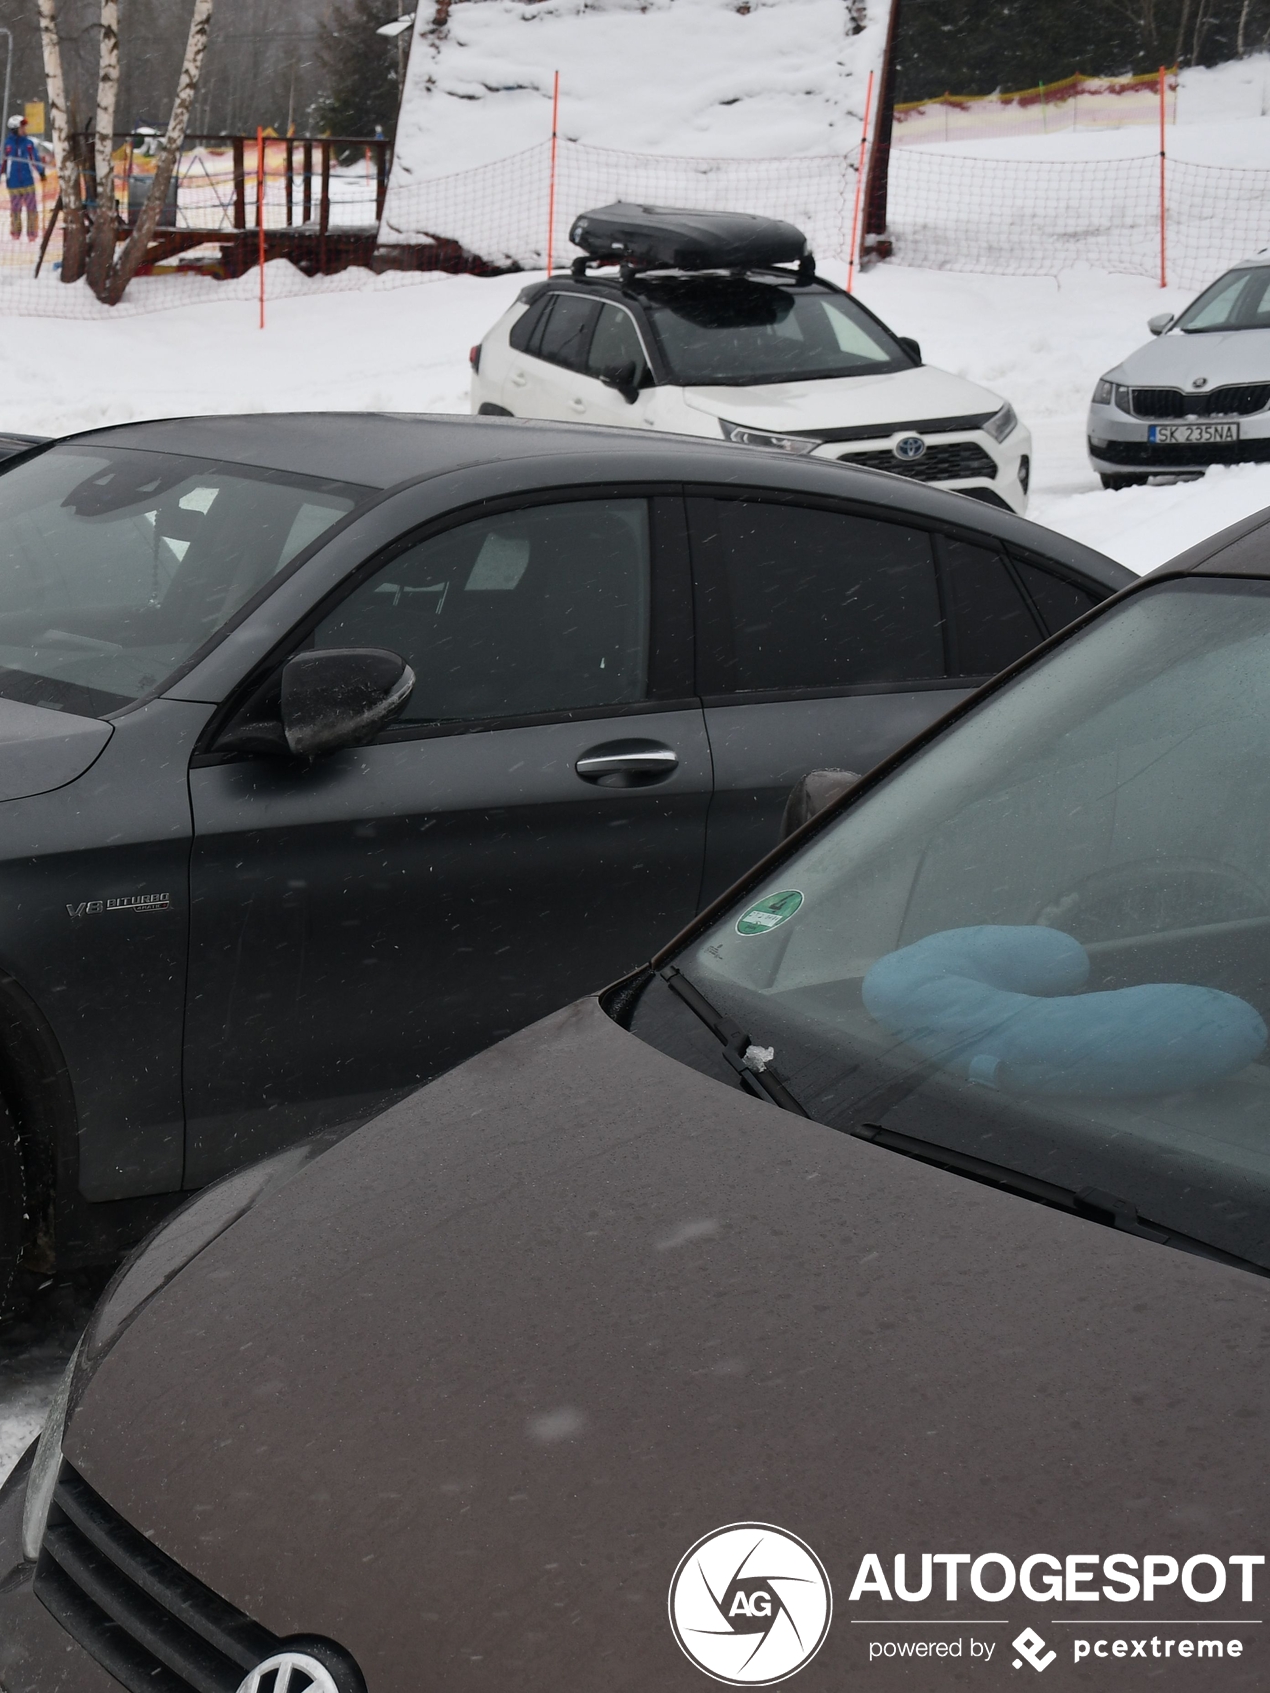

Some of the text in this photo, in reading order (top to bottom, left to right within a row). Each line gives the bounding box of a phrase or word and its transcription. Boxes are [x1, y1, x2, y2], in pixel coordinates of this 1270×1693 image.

[1158, 426, 1234, 442] SK 235NA
[66, 892, 170, 917] V8 BITURBO
